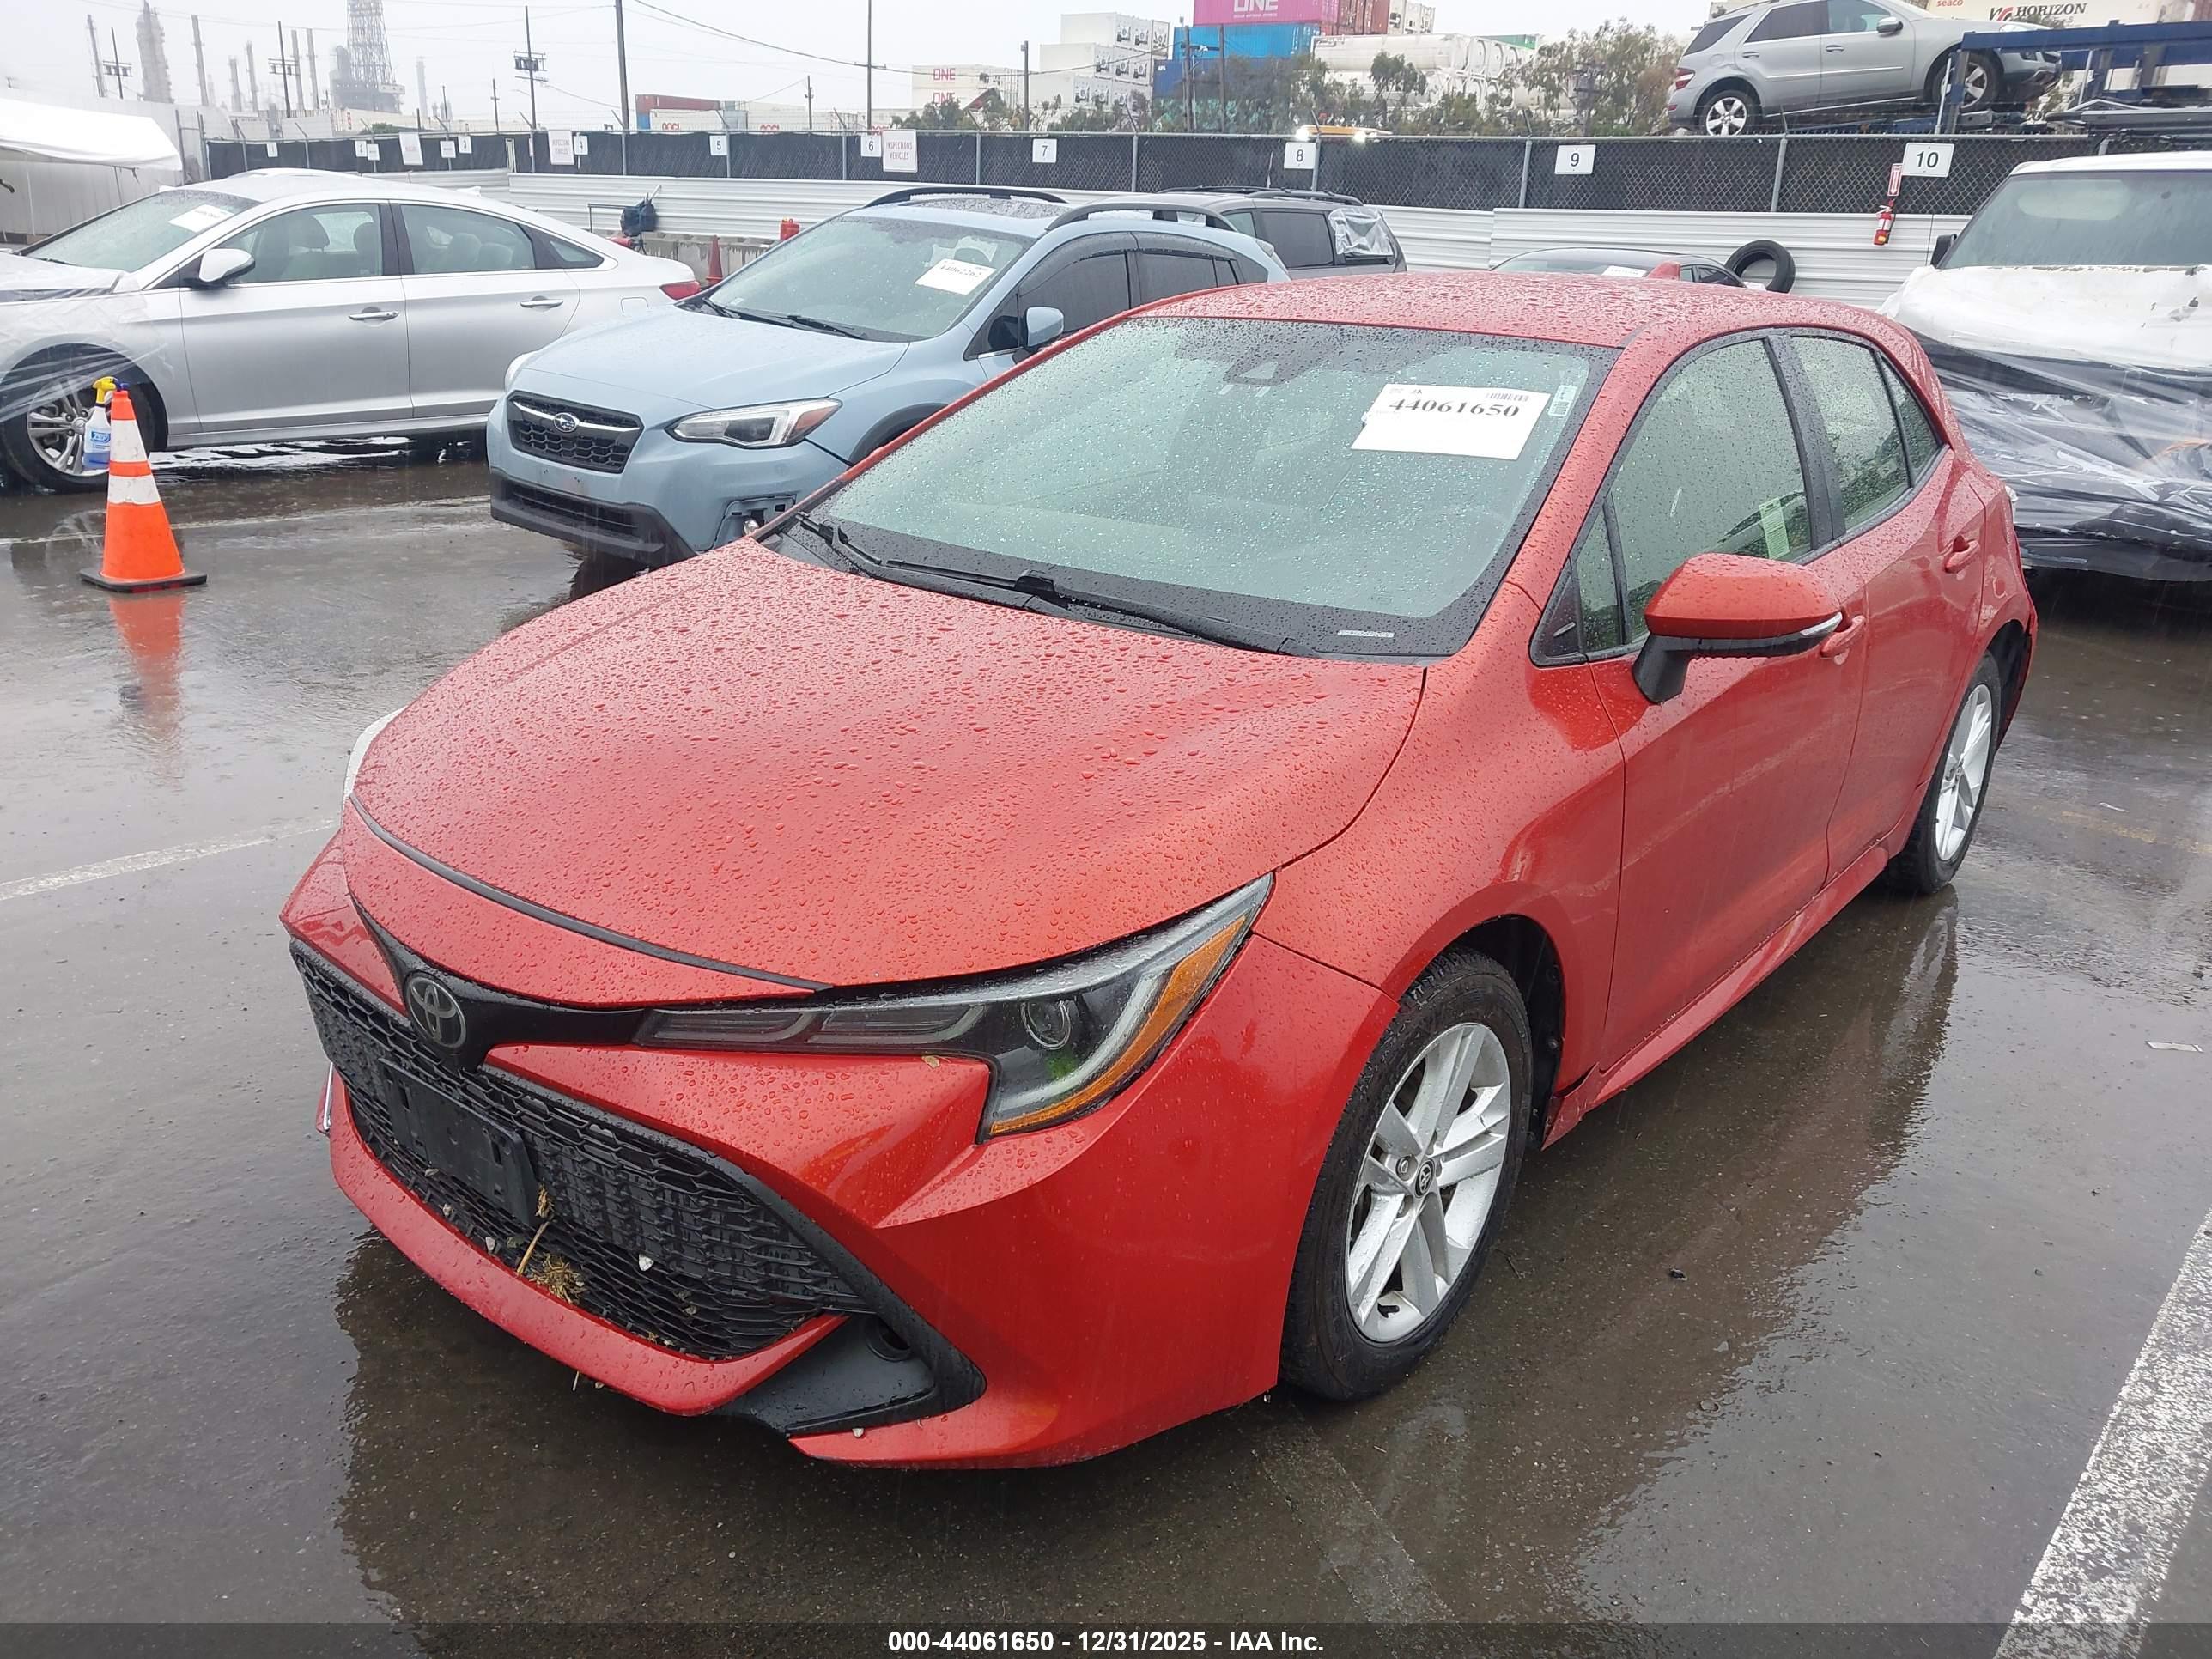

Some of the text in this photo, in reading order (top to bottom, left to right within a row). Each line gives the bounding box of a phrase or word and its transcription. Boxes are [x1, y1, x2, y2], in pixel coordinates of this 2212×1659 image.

[2015, 3, 2087, 17] HORIZON
[933, 68, 955, 80] ONE
[579, 141, 584, 151] 4
[716, 140, 721, 150] 5
[868, 140, 874, 151] 6
[1042, 145, 1048, 156] 7
[1297, 149, 1304, 161] 8
[1571, 153, 1580, 167] 9
[1917, 151, 1939, 168] 10
[1389, 398, 1520, 417] 44061650
